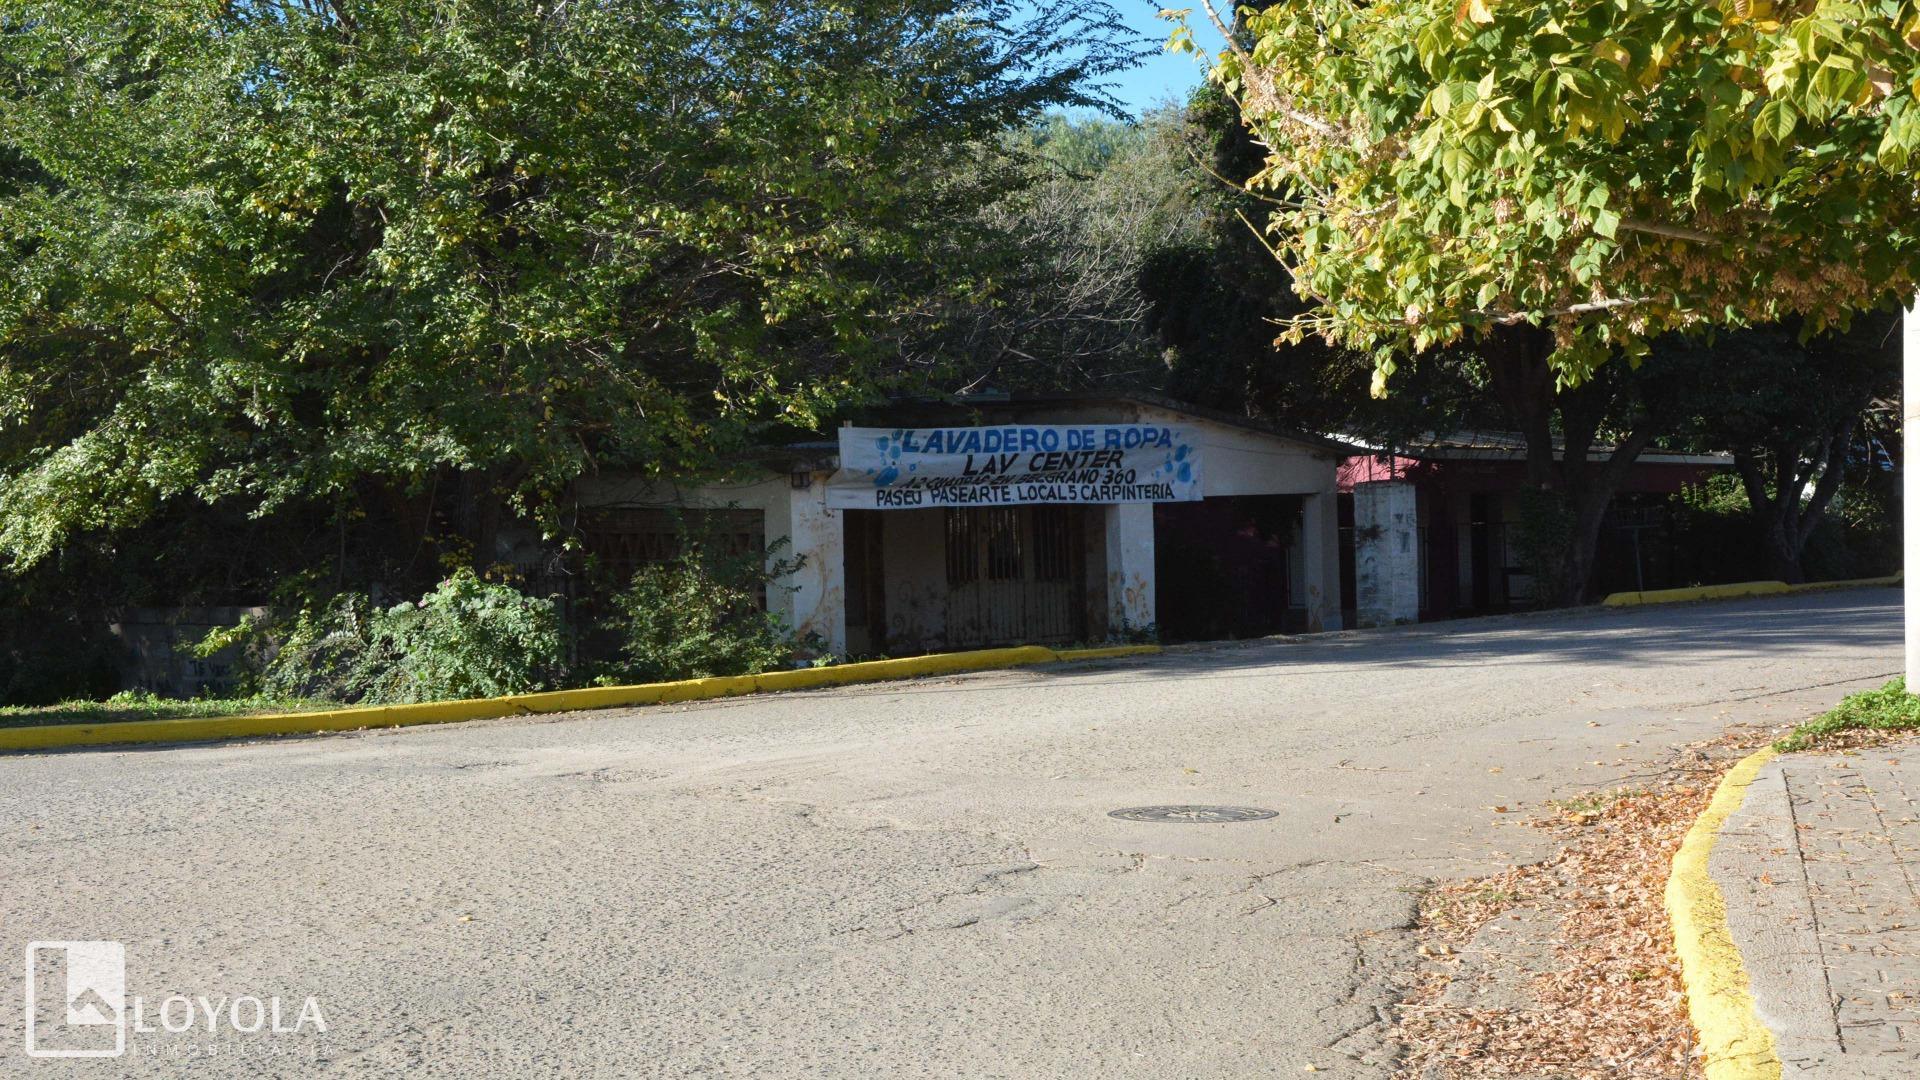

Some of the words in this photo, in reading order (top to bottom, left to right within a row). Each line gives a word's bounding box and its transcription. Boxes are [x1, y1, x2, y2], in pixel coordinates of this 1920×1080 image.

[901, 428, 1060, 454] LAVADERO
[1066, 428, 1096, 451] DE
[1104, 427, 1173, 450] ROPA
[963, 453, 1019, 477] LAV
[1028, 450, 1124, 473] CENTER
[1081, 483, 1176, 501] CARPINTERIA
